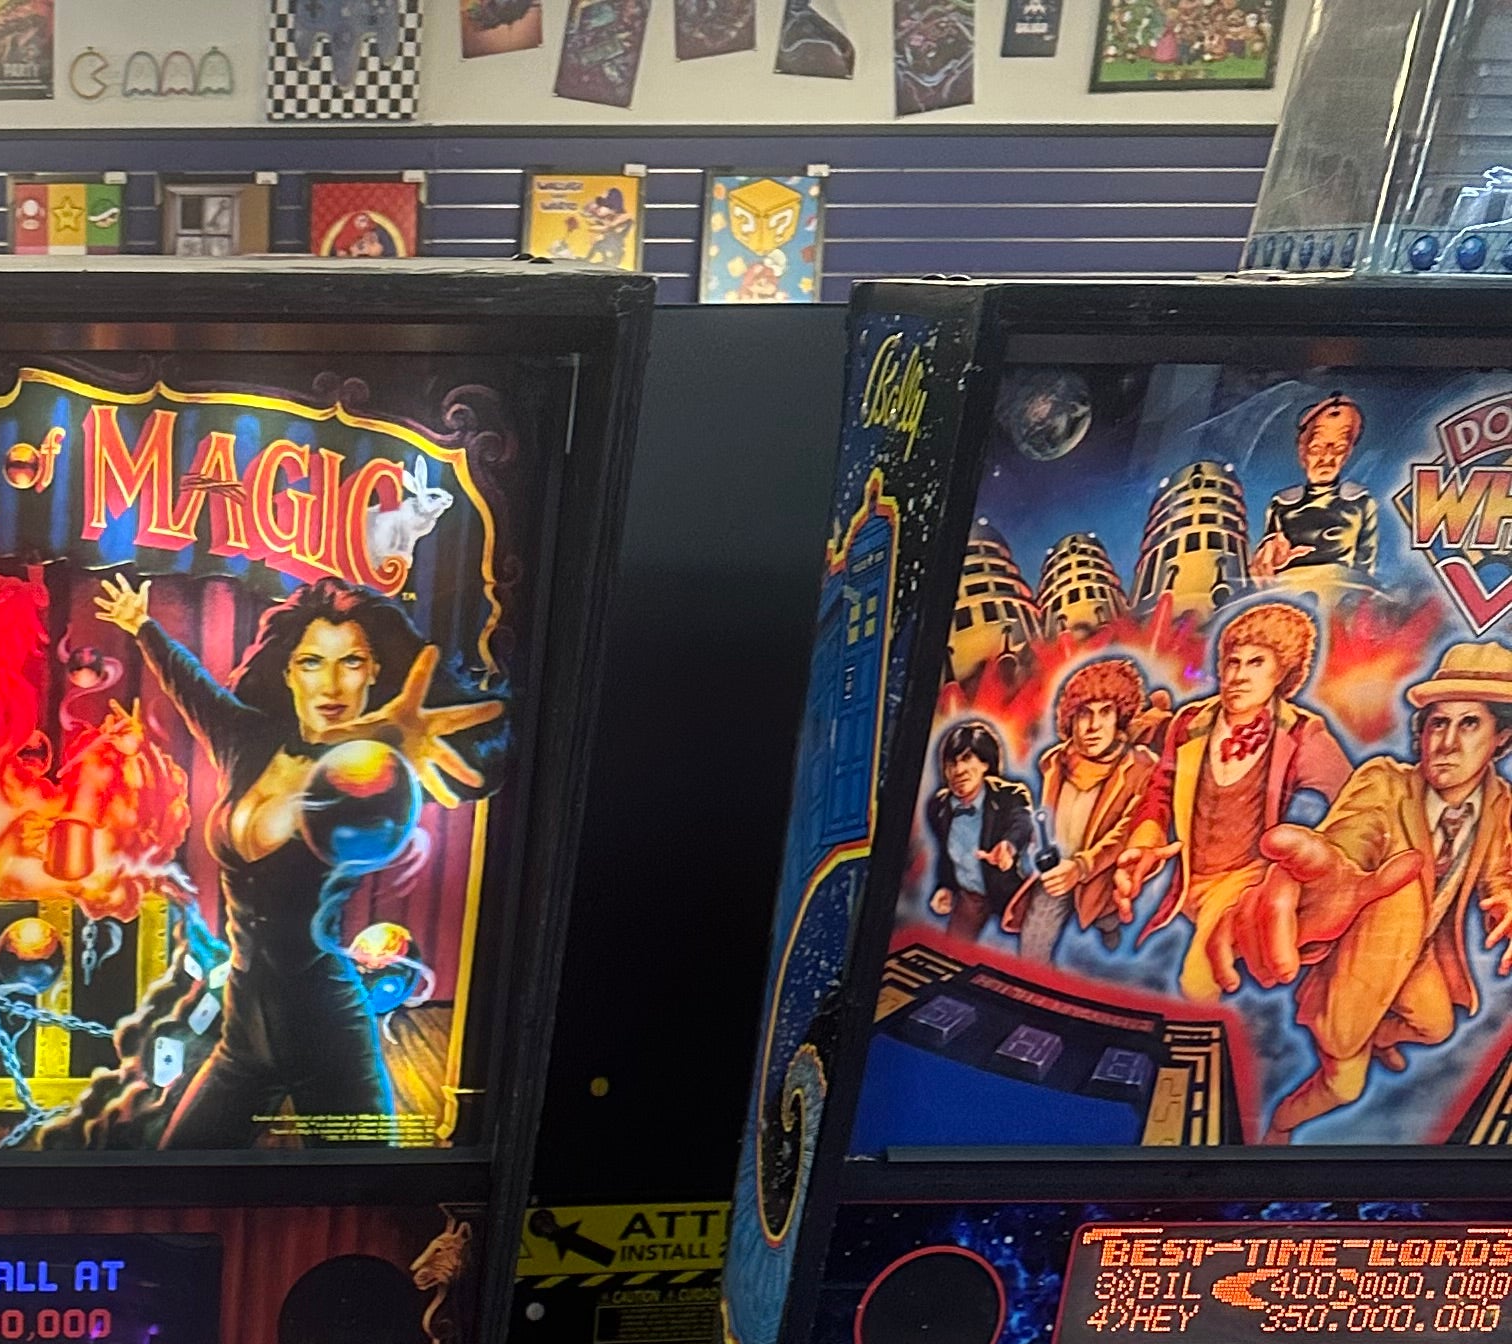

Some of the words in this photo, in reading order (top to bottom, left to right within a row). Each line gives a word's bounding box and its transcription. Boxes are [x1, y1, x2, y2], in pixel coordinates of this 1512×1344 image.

[2, 426, 67, 494] of
[81, 404, 410, 598] MAGIC
[620, 1242, 711, 1262] INSTALL
[1100, 1238, 1205, 1267] BEST
[1245, 1238, 1340, 1267] TIME
[74, 1260, 125, 1292] AT
